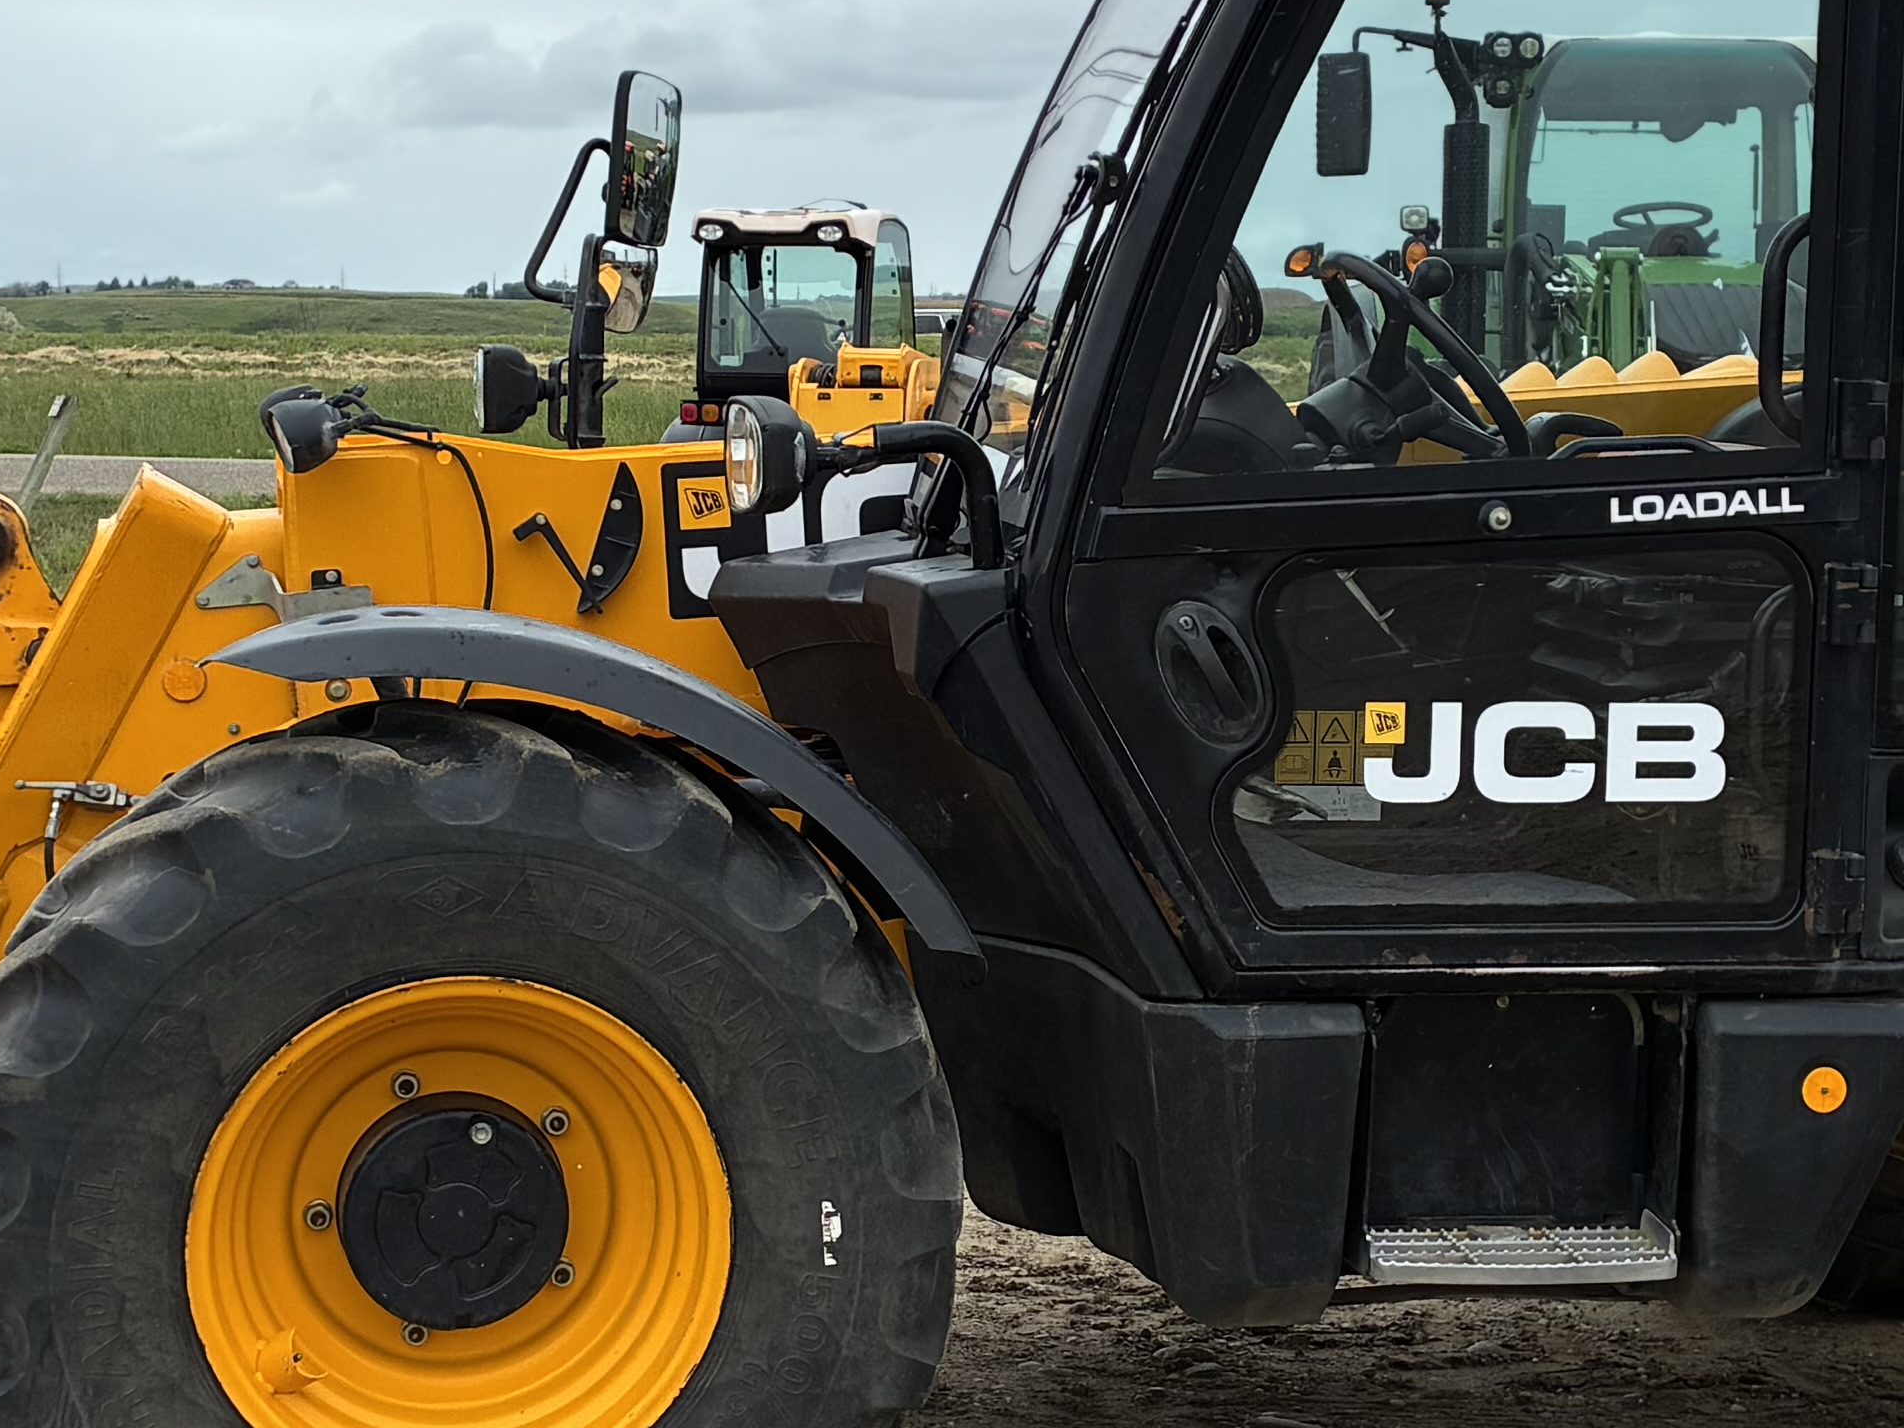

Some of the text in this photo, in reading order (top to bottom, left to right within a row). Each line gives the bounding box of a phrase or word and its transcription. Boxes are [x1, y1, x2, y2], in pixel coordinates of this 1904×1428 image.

[690, 490, 722, 516] JCB
[1609, 487, 1806, 524] LOADALL
[1375, 712, 1401, 733] JCB
[1363, 701, 1727, 804] JCB
[492, 866, 842, 1172] ADVANCE
